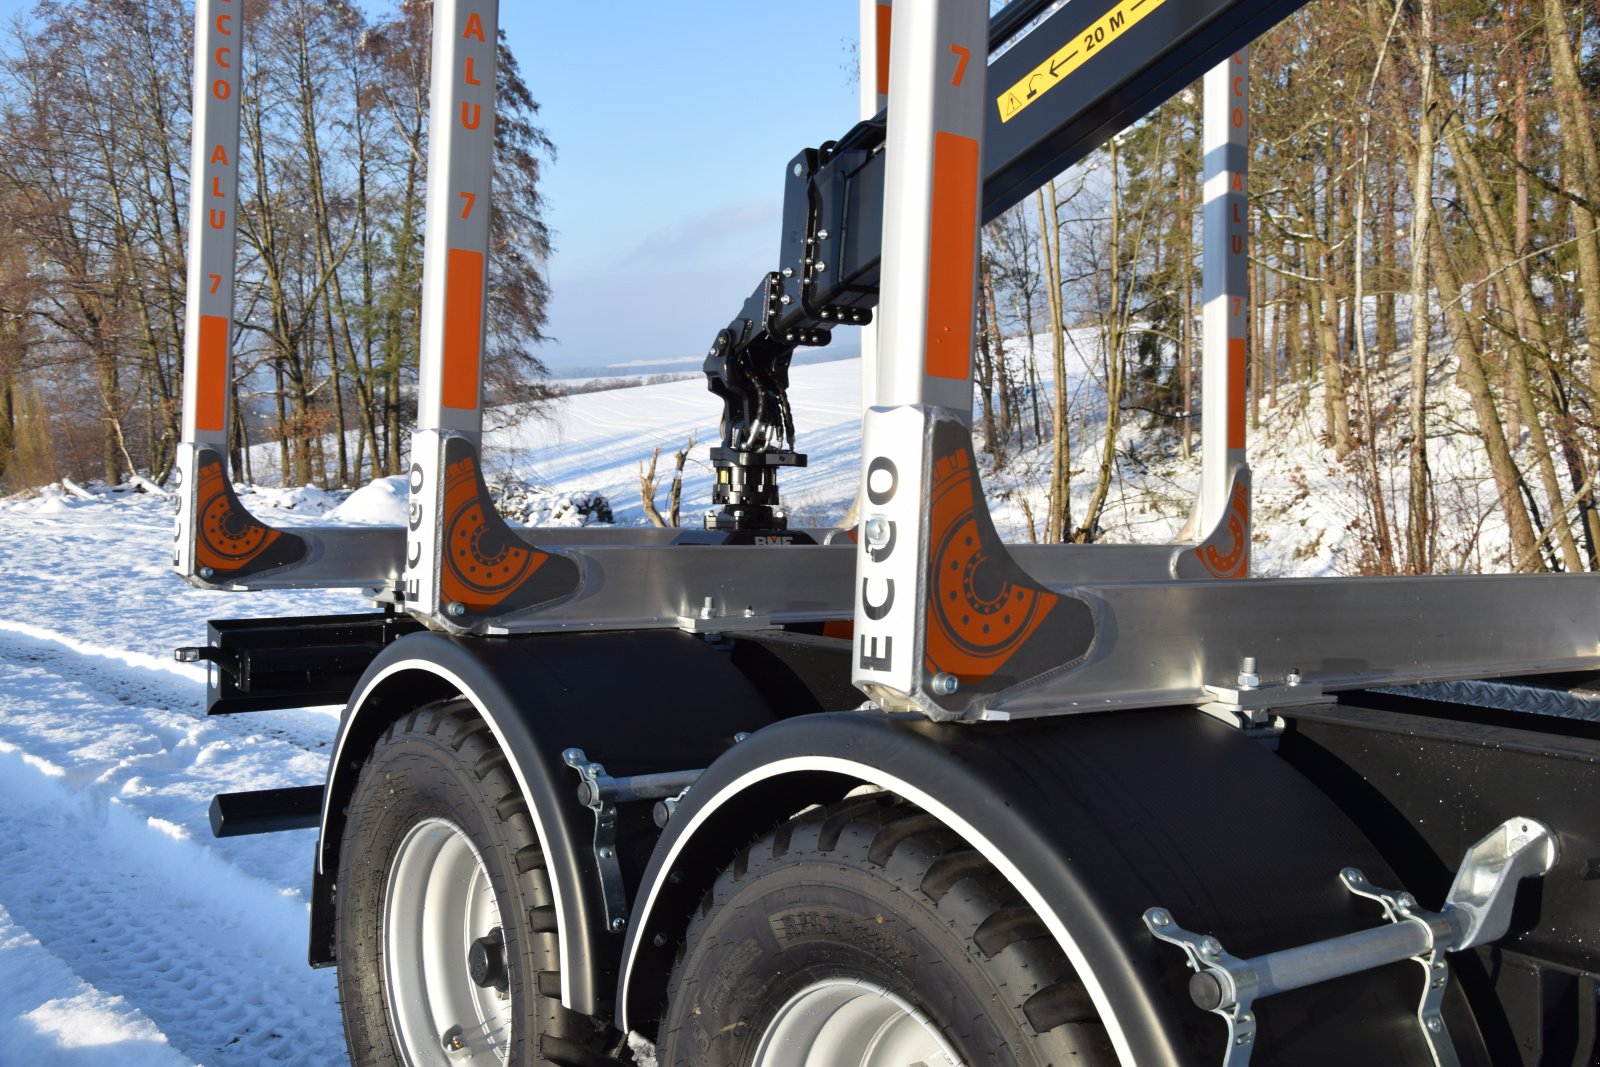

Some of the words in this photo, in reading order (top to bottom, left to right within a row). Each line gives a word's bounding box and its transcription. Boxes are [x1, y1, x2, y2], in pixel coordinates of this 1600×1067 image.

[213, 0, 232, 100] CCO
[461, 12, 485, 131] ALU
[950, 44, 970, 87] 7
[1084, 26, 1105, 52] 20
[1109, 10, 1125, 32] M
[210, 145, 228, 230] ALU
[459, 191, 476, 219] 7
[1231, 171, 1243, 254] ALU
[208, 273, 222, 294] 7
[1232, 297, 1241, 316] 7
[405, 462, 424, 603] ECCO
[860, 456, 899, 672] ECCO
